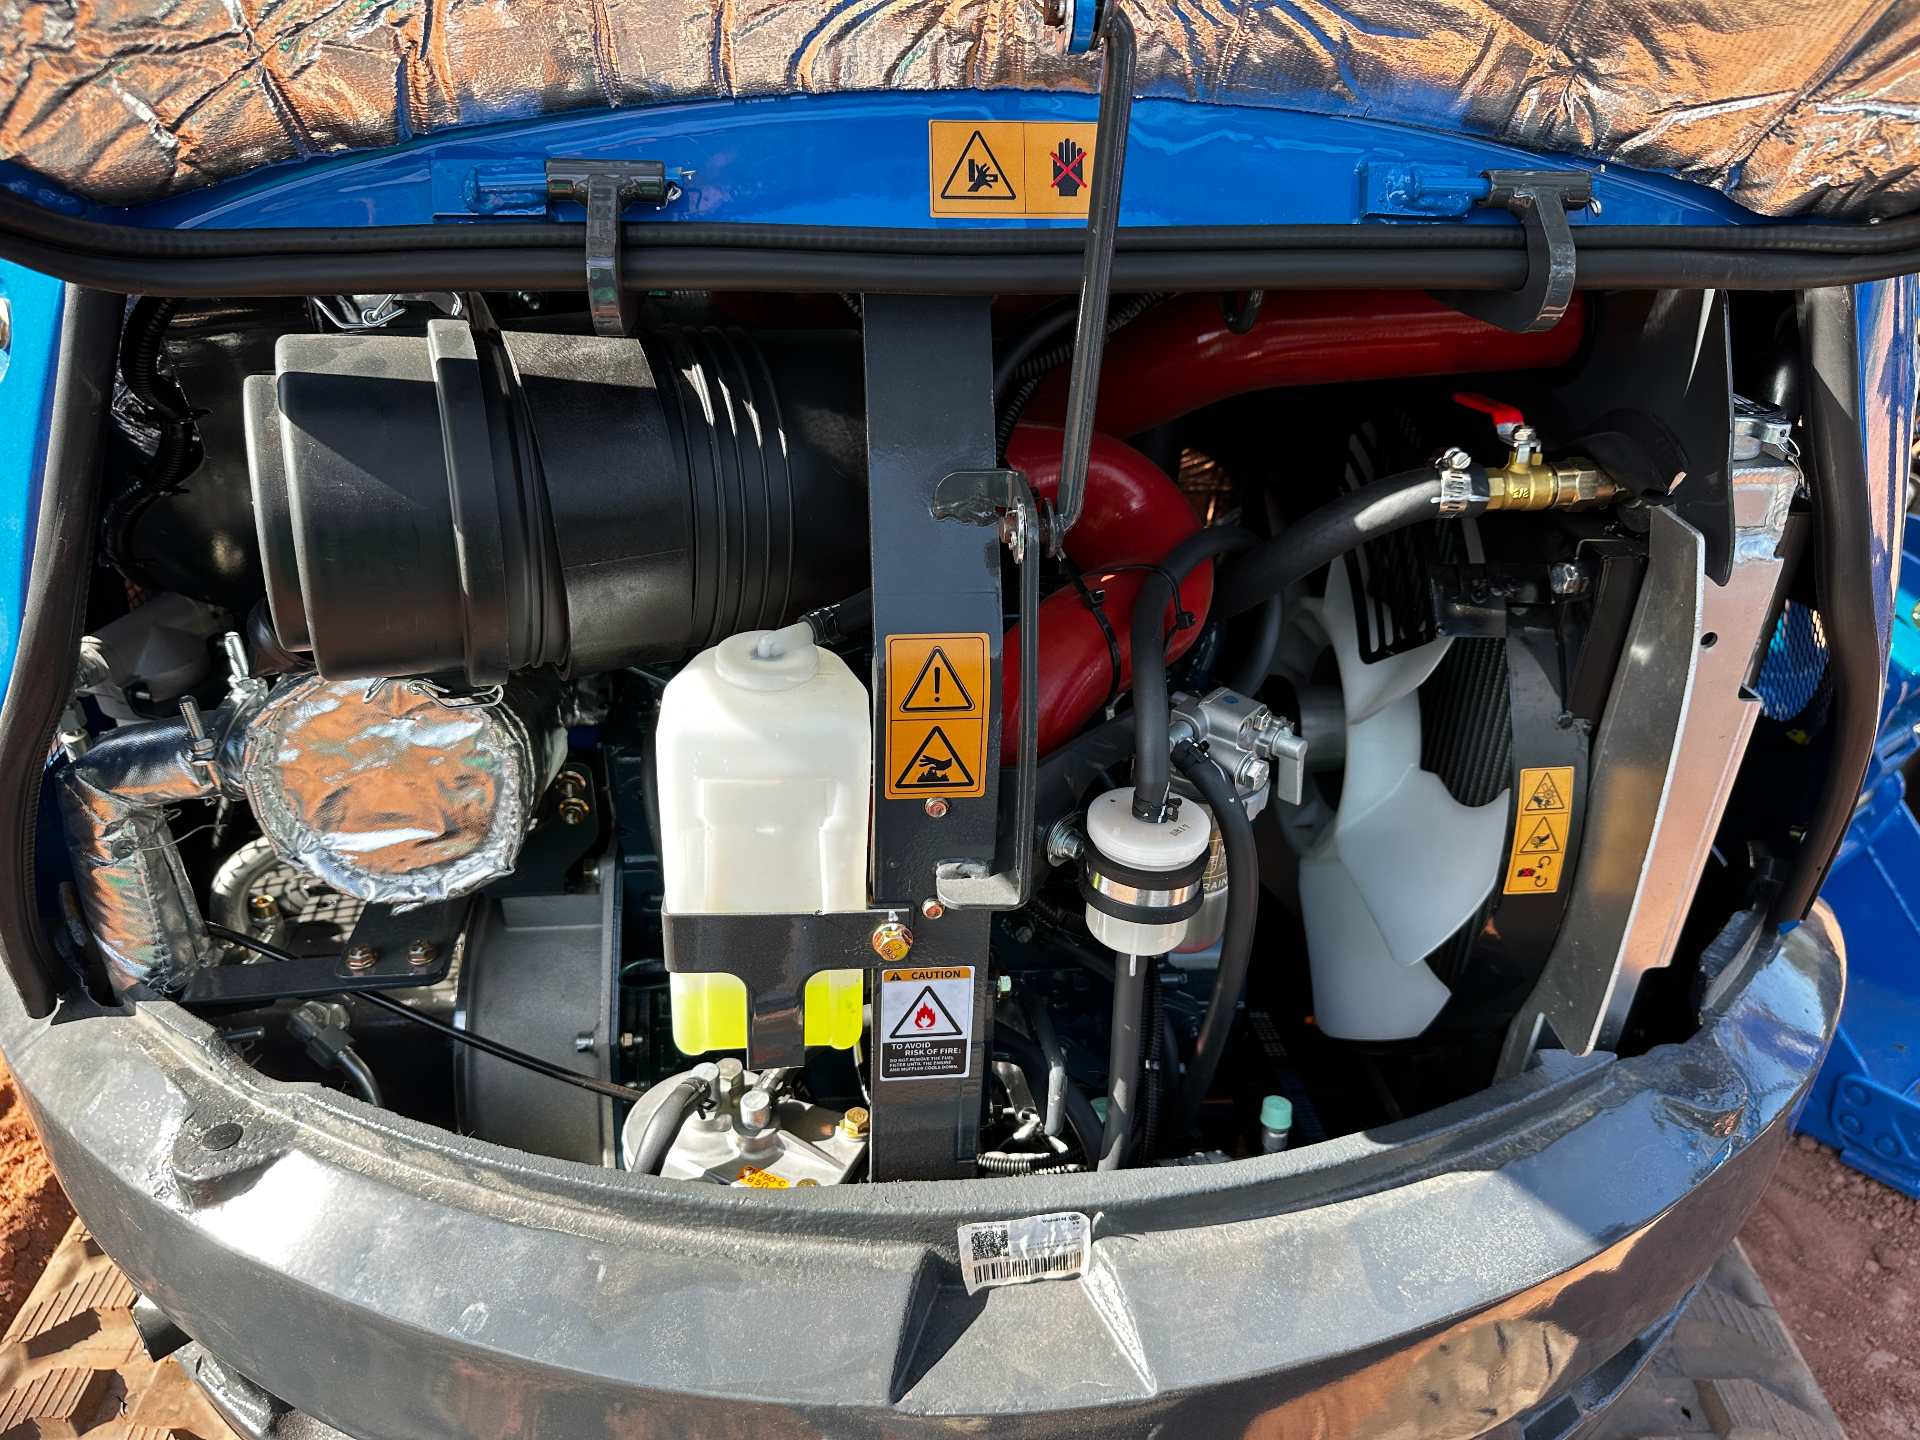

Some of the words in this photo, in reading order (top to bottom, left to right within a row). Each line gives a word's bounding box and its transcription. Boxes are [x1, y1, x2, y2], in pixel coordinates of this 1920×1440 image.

[1203, 878, 1228, 893] RAIN
[911, 970, 961, 980] CAUTION
[905, 1042, 931, 1050] AVOID
[940, 1047, 961, 1055] FIRE:
